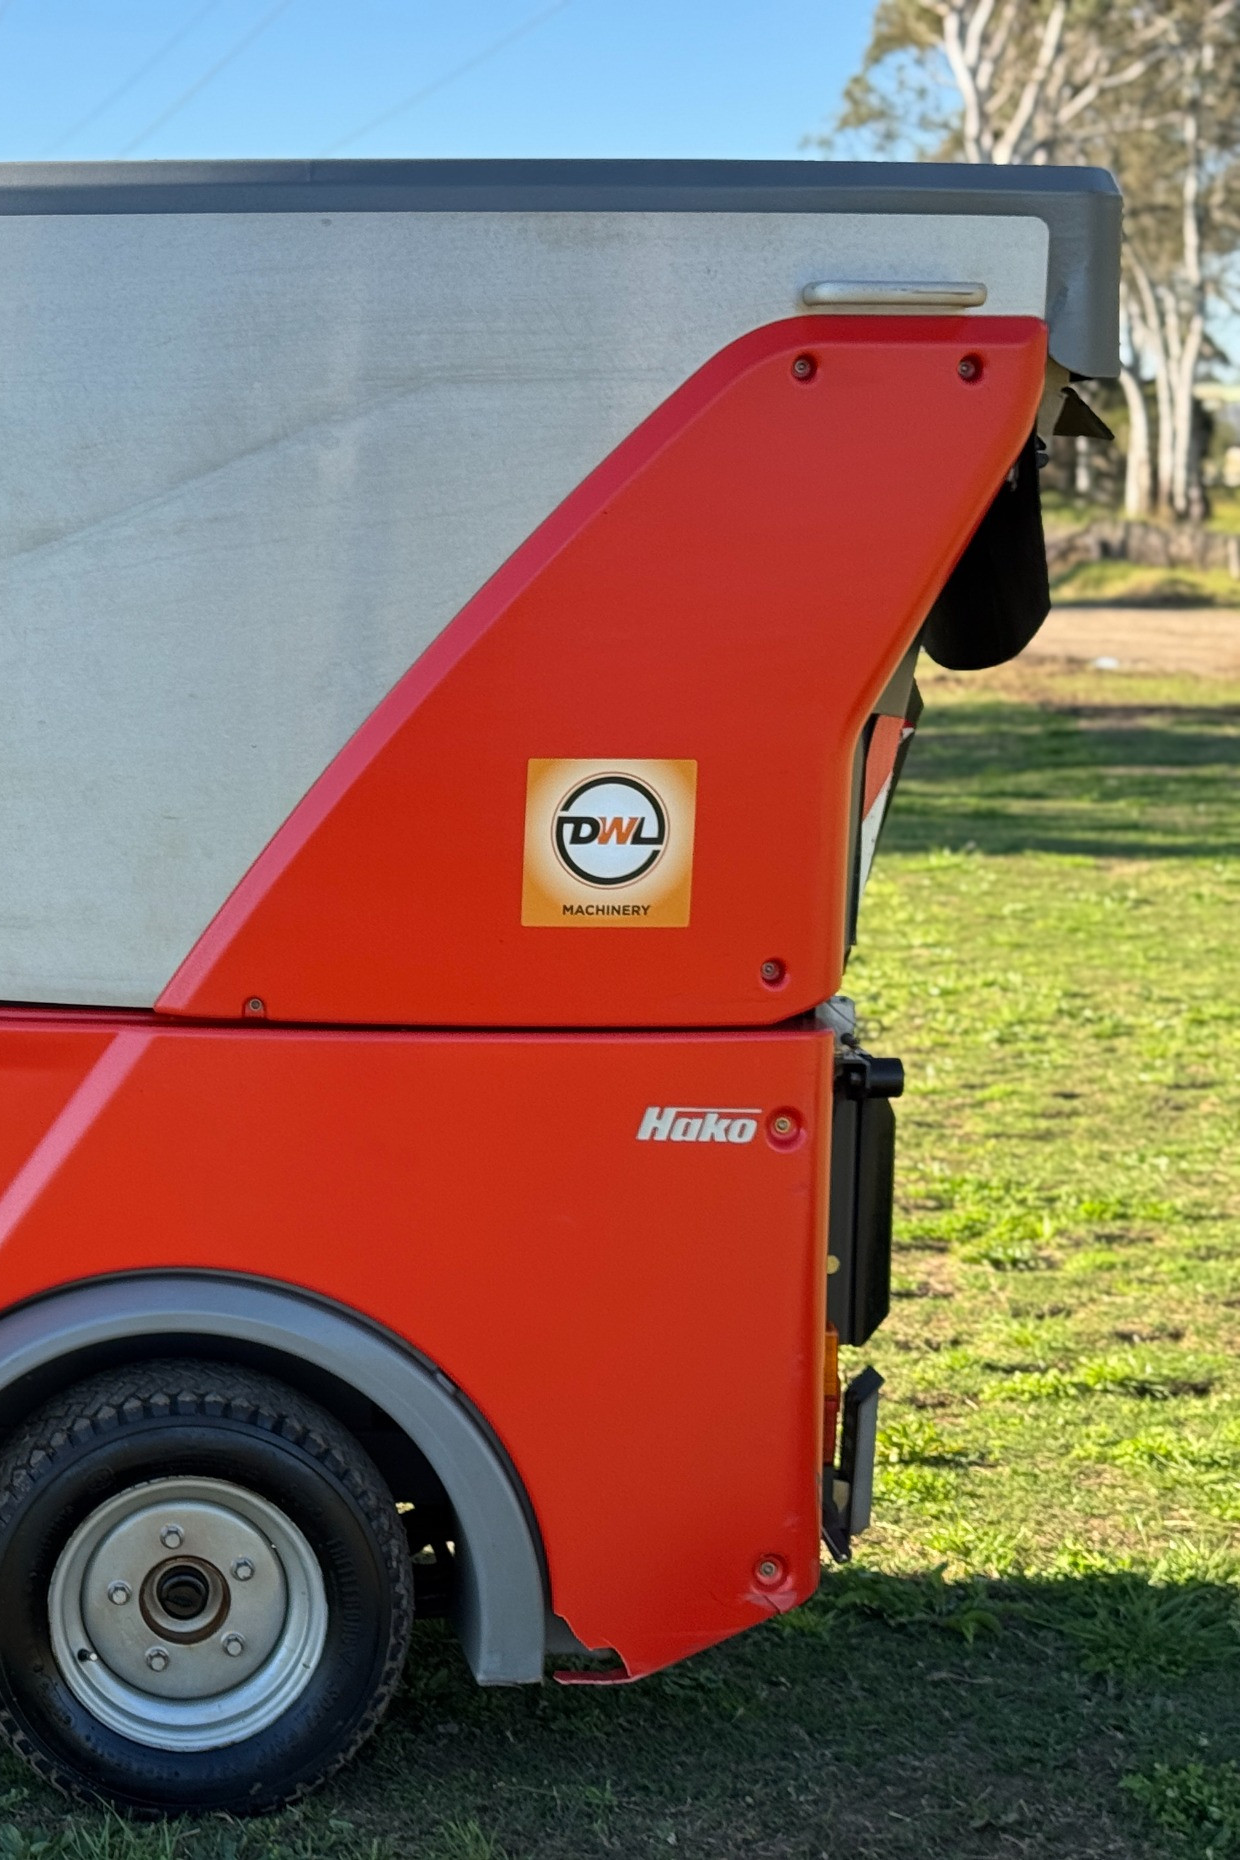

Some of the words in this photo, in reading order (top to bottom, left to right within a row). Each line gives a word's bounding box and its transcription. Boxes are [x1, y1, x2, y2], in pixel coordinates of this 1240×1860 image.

[558, 816, 663, 845] DWL
[562, 904, 651, 916] MACHINERY
[636, 1106, 760, 1144] Hako
